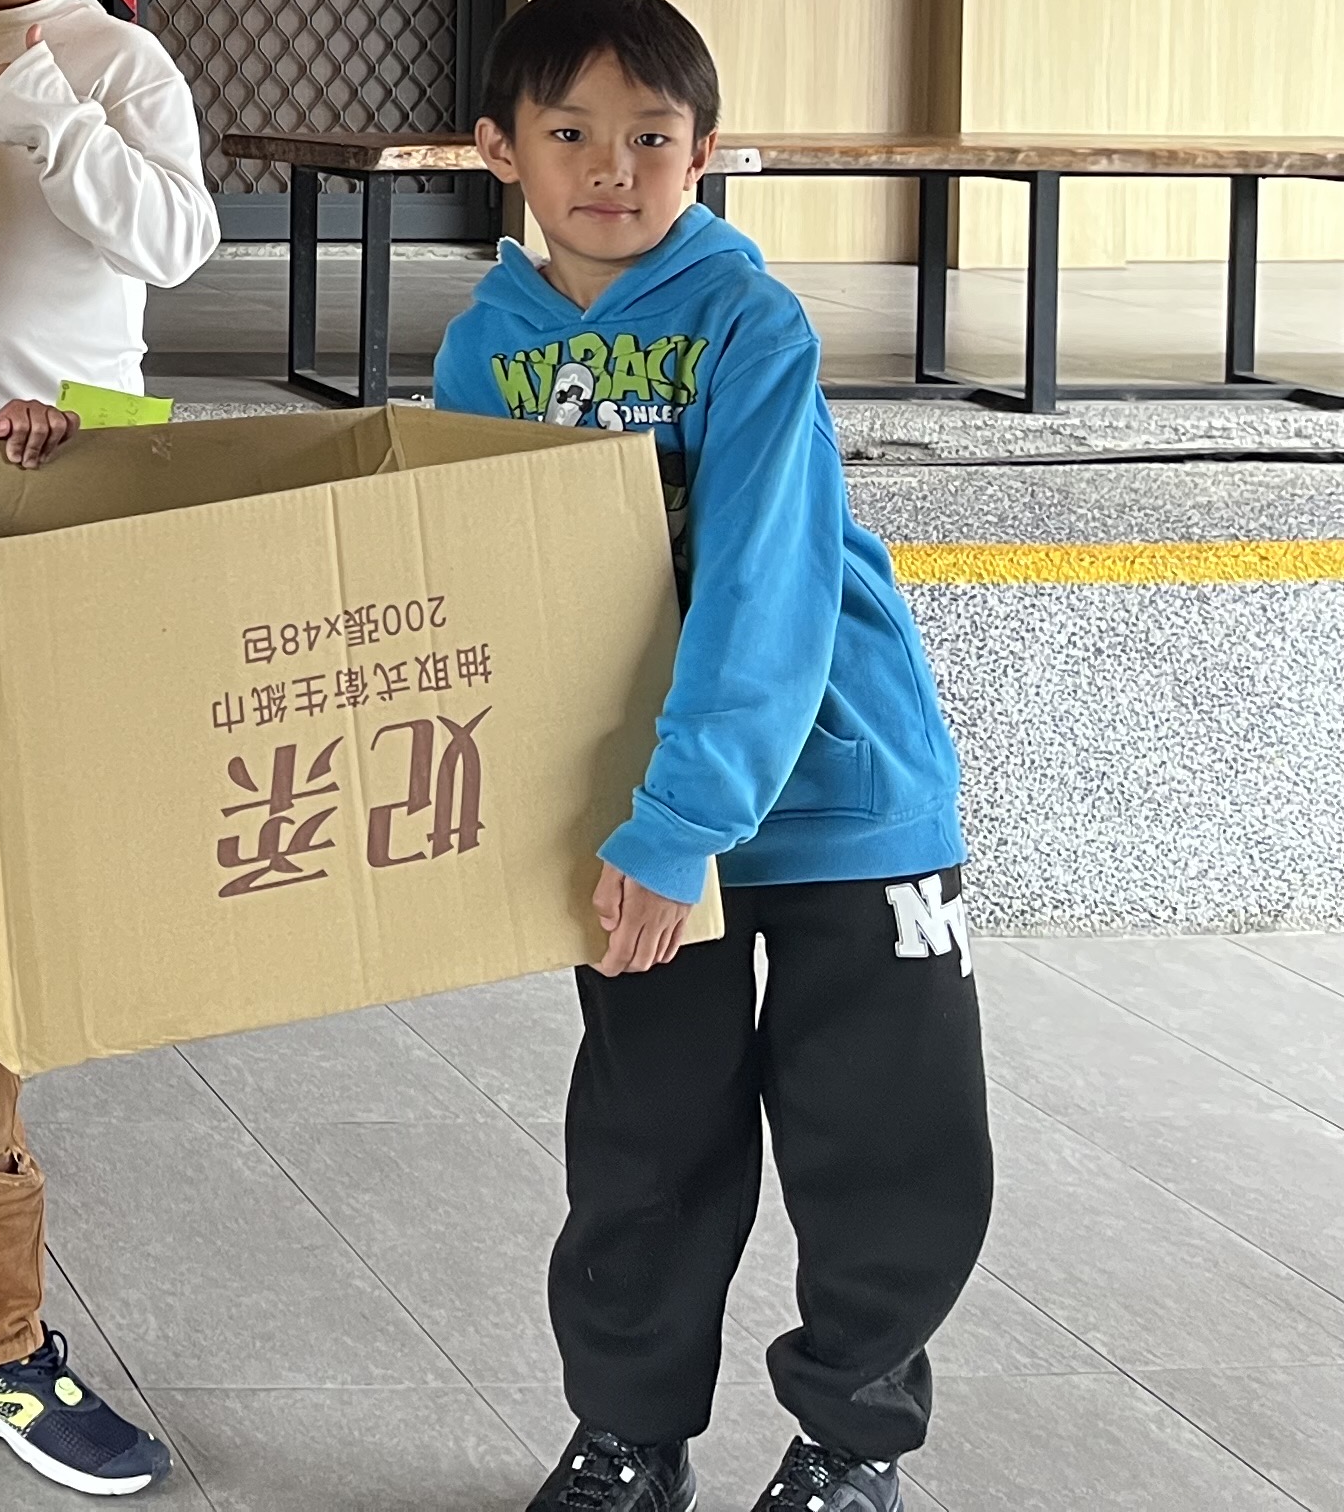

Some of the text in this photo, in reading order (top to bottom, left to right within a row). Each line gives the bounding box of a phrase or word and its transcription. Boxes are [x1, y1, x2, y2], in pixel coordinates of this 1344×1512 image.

[568, 331, 710, 407] BACK
[211, 642, 493, 734] 抽取式衛生紙巾
[216, 705, 494, 899] 妃柔
